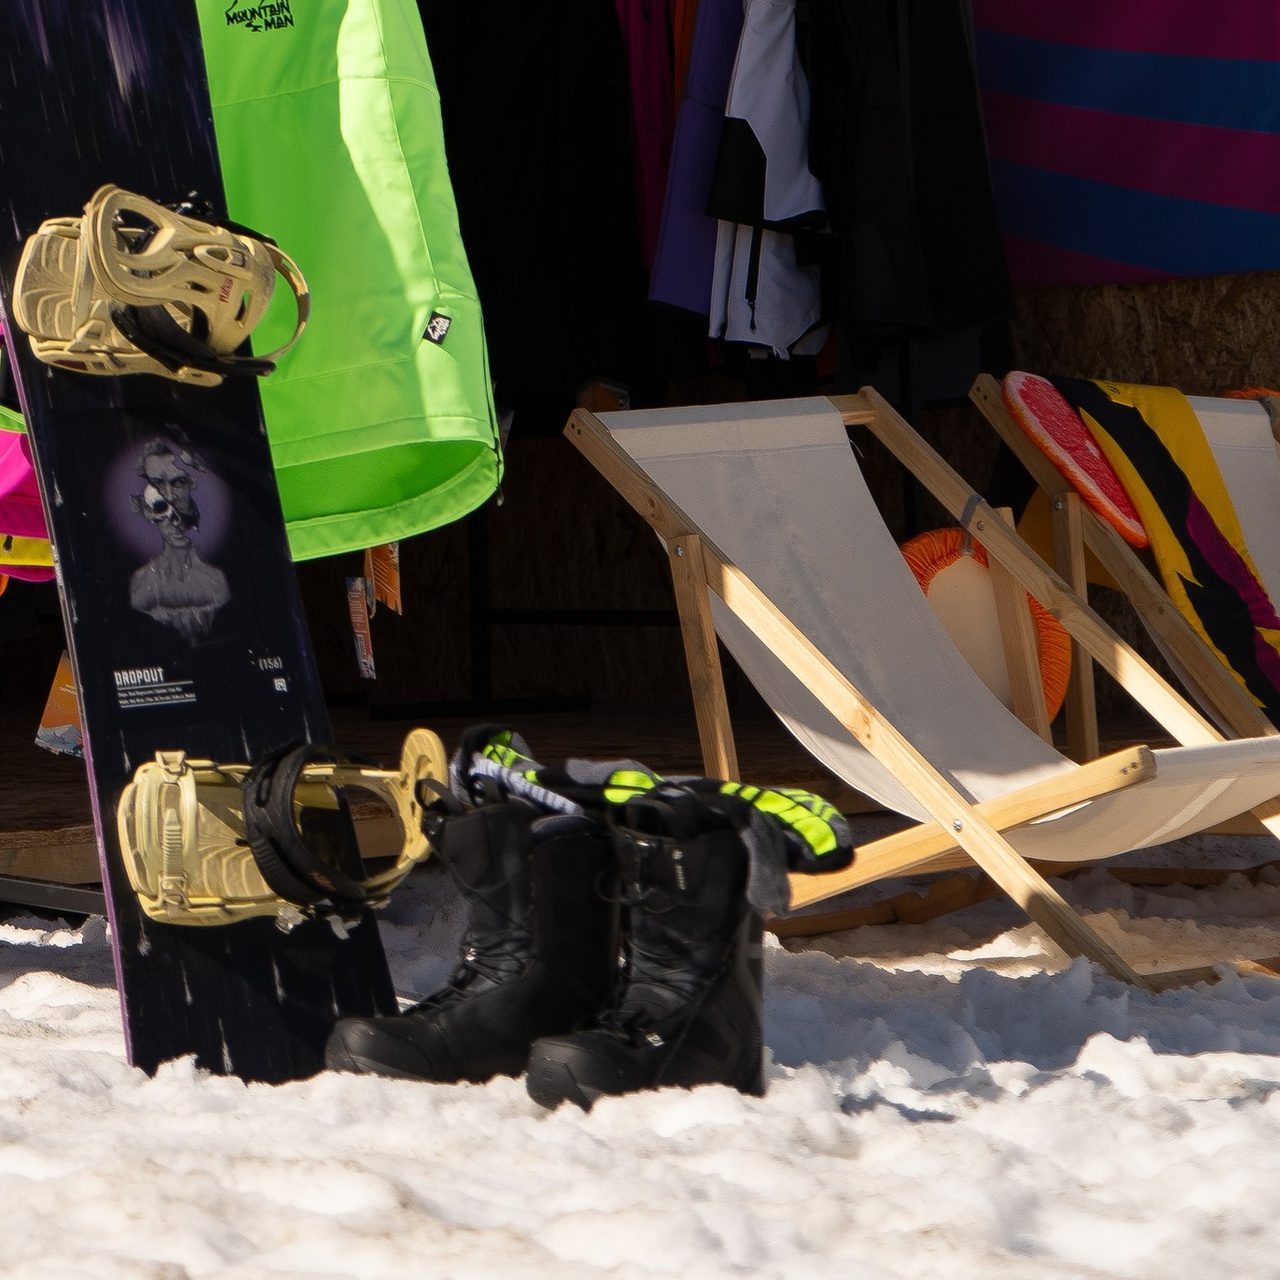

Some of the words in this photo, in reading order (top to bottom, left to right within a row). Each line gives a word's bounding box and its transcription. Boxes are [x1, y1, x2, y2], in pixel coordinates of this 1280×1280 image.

[226, 4, 292, 26] MOUNTAIN
[264, 15, 295, 31] MAN
[113, 666, 164, 686] DROPOUT
